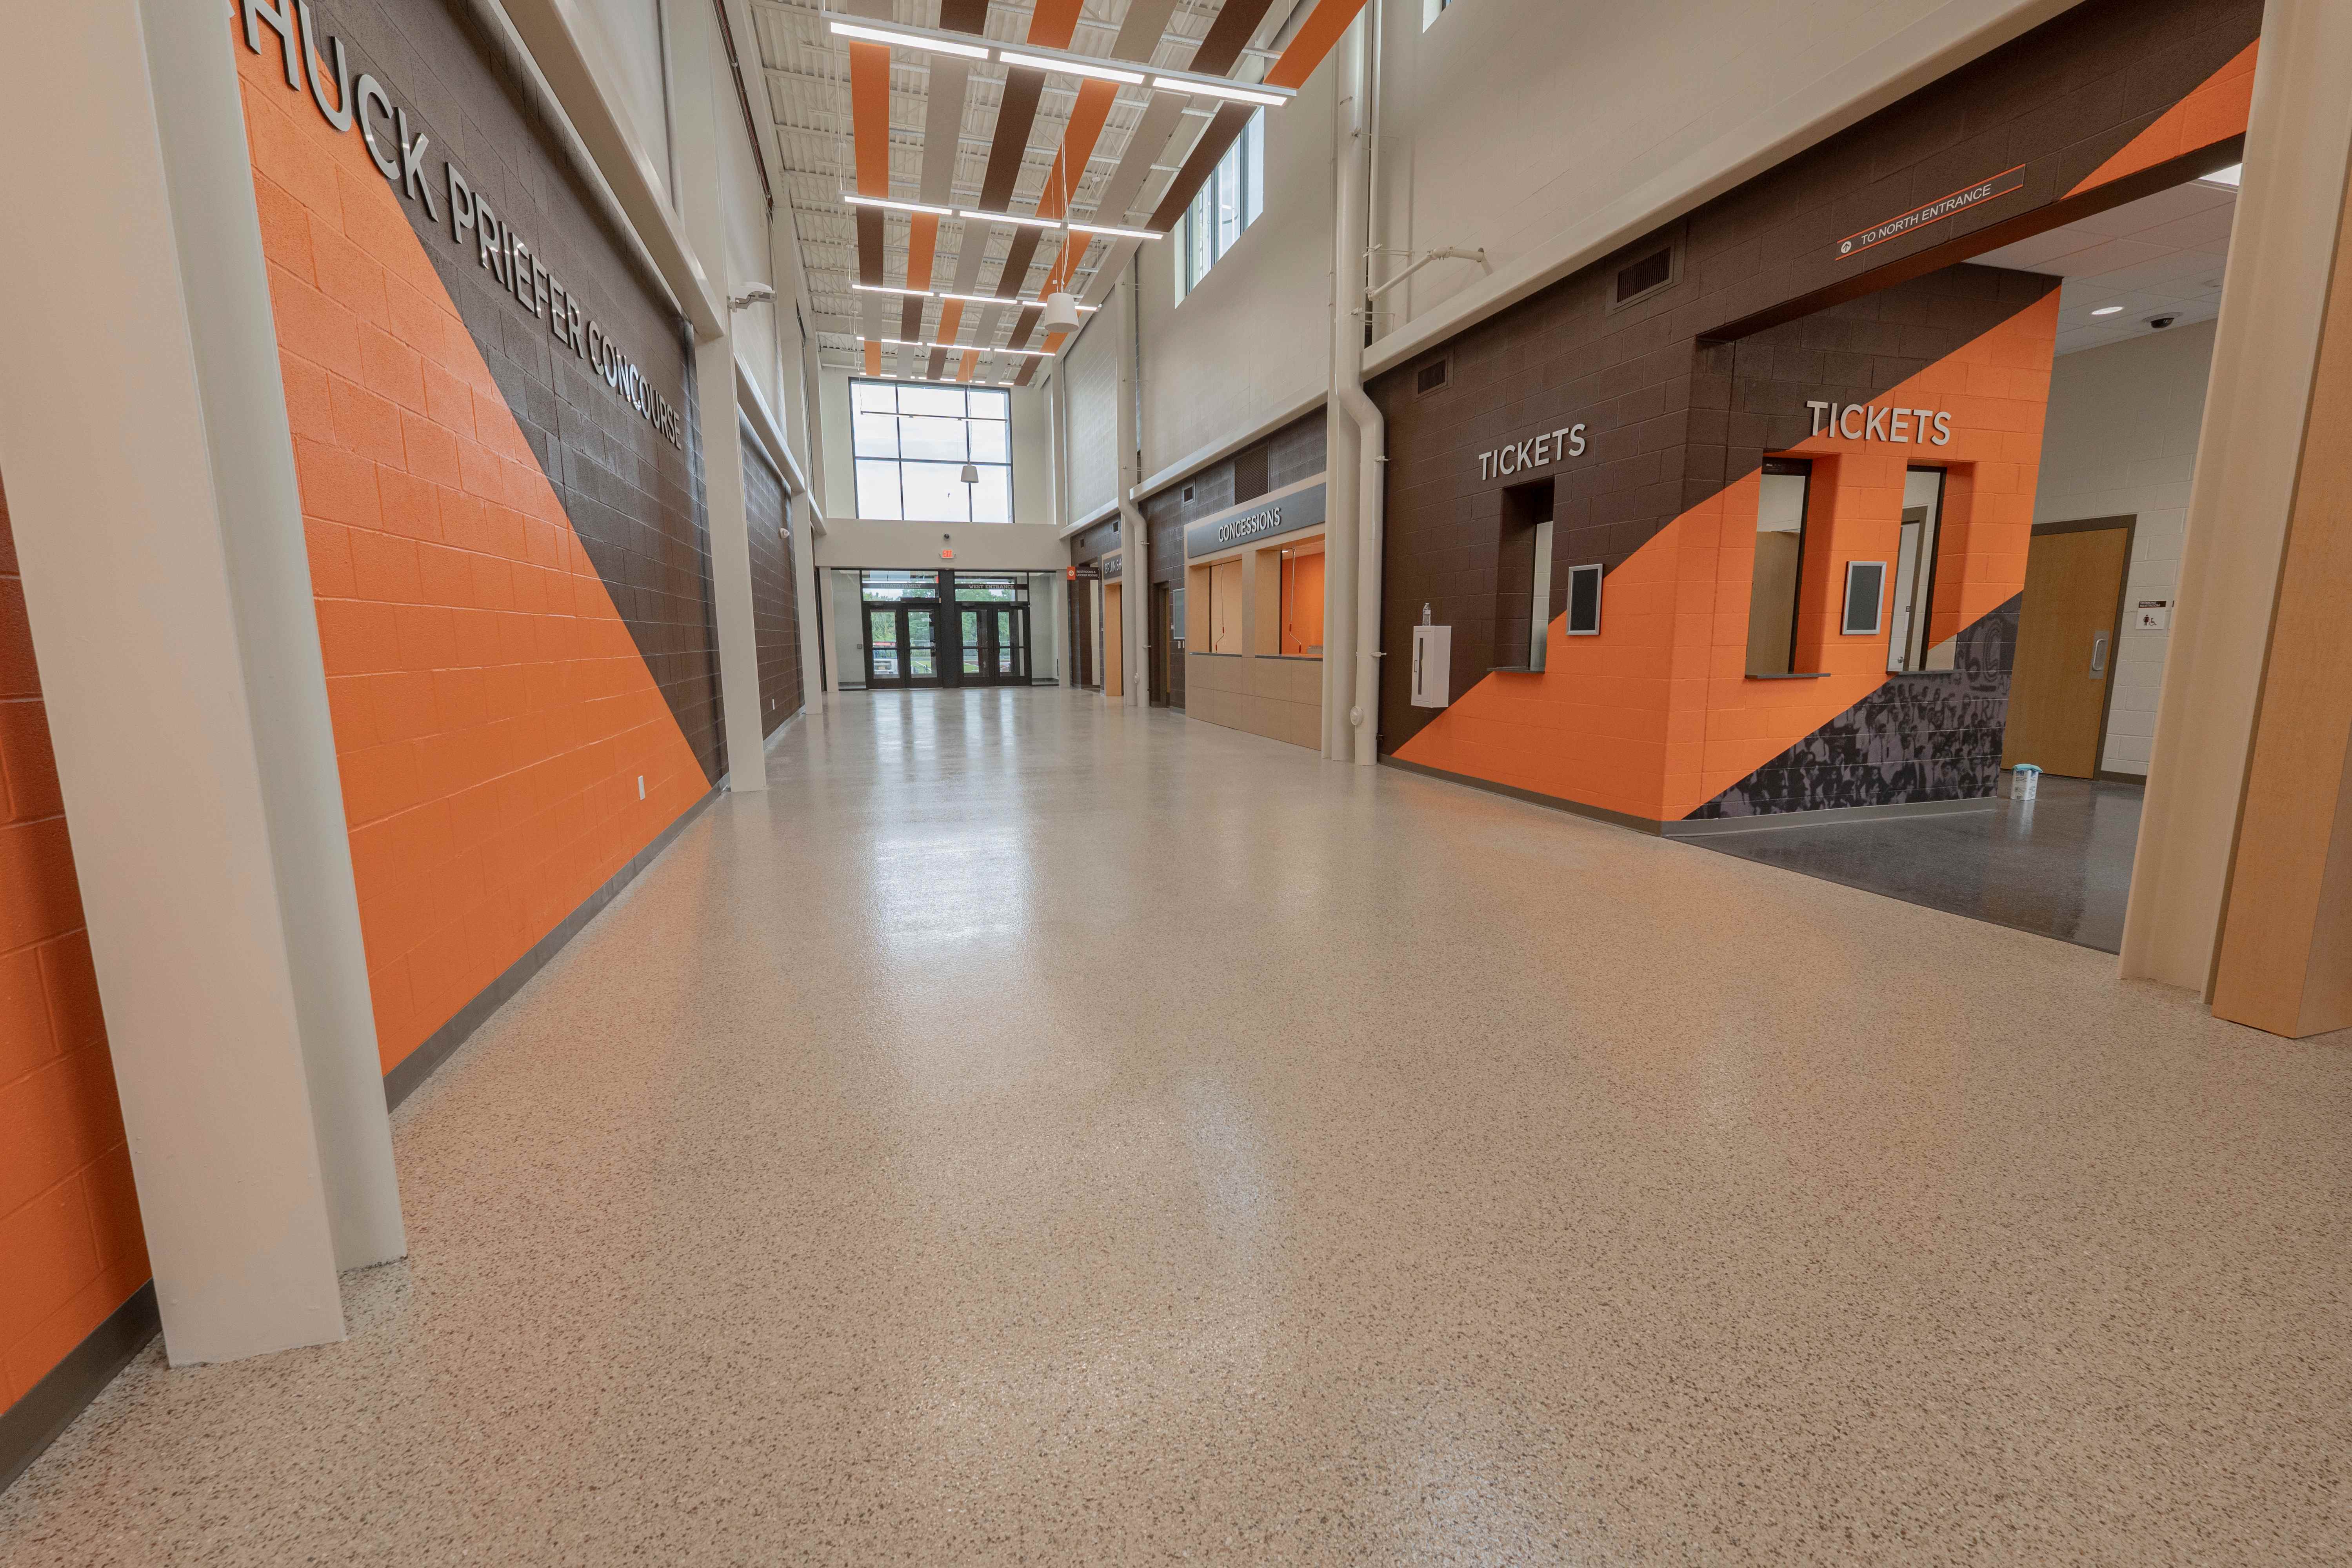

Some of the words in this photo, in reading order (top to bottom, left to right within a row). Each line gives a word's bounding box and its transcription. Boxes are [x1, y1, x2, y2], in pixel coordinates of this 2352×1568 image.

[229, 0, 439, 222] HUCK
[445, 161, 583, 359] PRIEFER
[588, 321, 682, 451] CONCOURSE
[1861, 232, 1876, 245] TO
[1878, 214, 1918, 239] NORTH
[1921, 184, 1992, 220] ENTRANCE
[1807, 401, 1952, 445] TICKETS
[1478, 423, 1587, 481] TICKETS
[1218, 507, 1281, 543] CONCESSIONS
[1105, 561, 1116, 574] BRUIN
